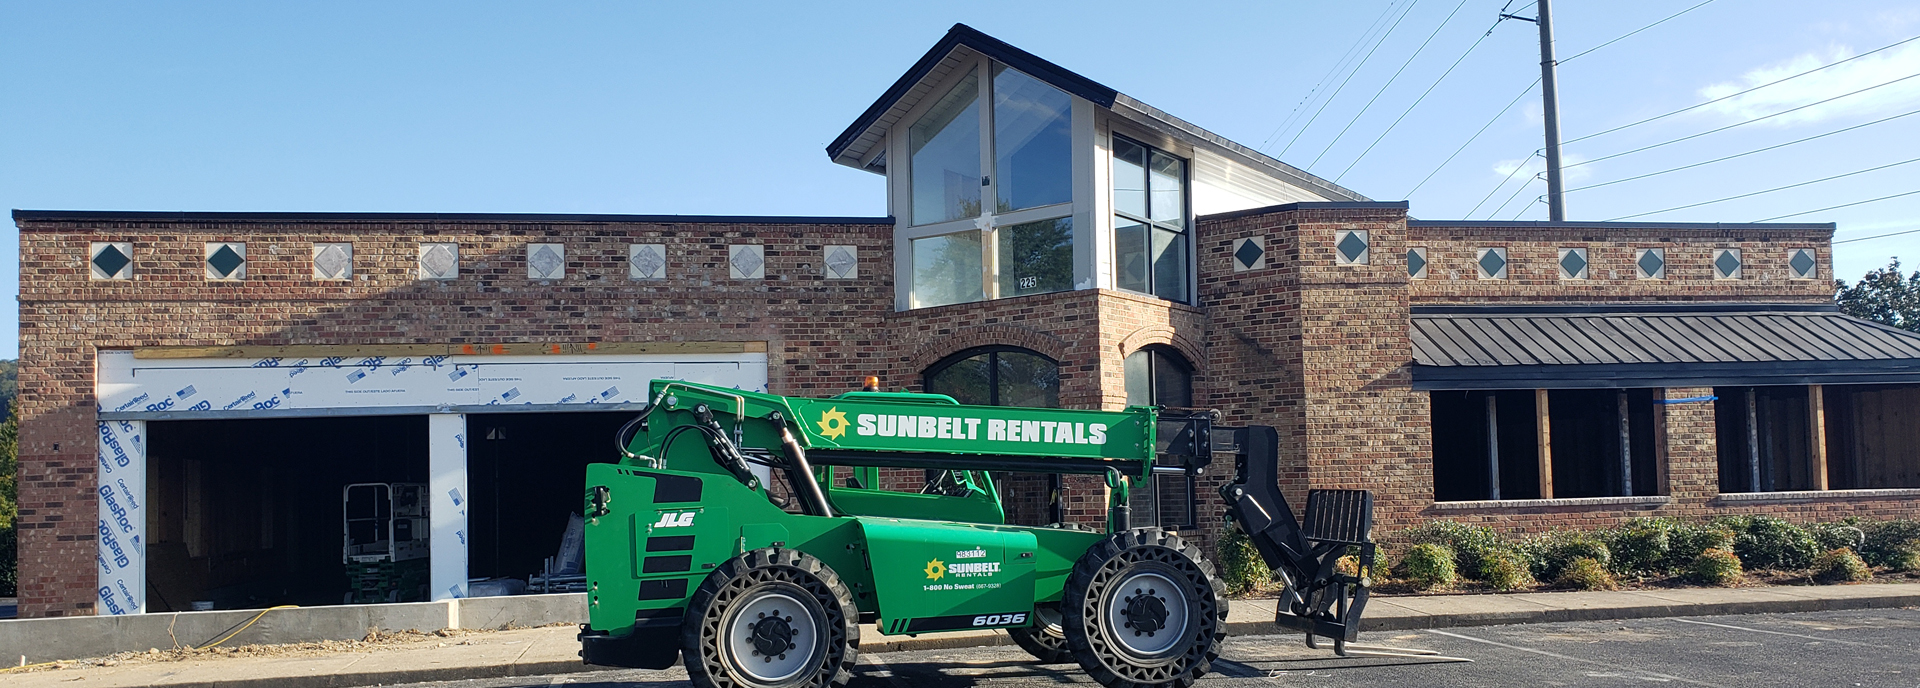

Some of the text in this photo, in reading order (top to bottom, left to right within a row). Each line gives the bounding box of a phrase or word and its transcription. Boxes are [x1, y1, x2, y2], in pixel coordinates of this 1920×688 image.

[1020, 277, 1036, 288] 225
[856, 413, 1107, 445] SUNBELT RENTALS
[99, 484, 133, 534] GlasRoc
[653, 512, 696, 528] JLG
[99, 520, 129, 569] GlasRoc
[948, 562, 1000, 574] SUNBELT
[972, 613, 1026, 627] 6036
